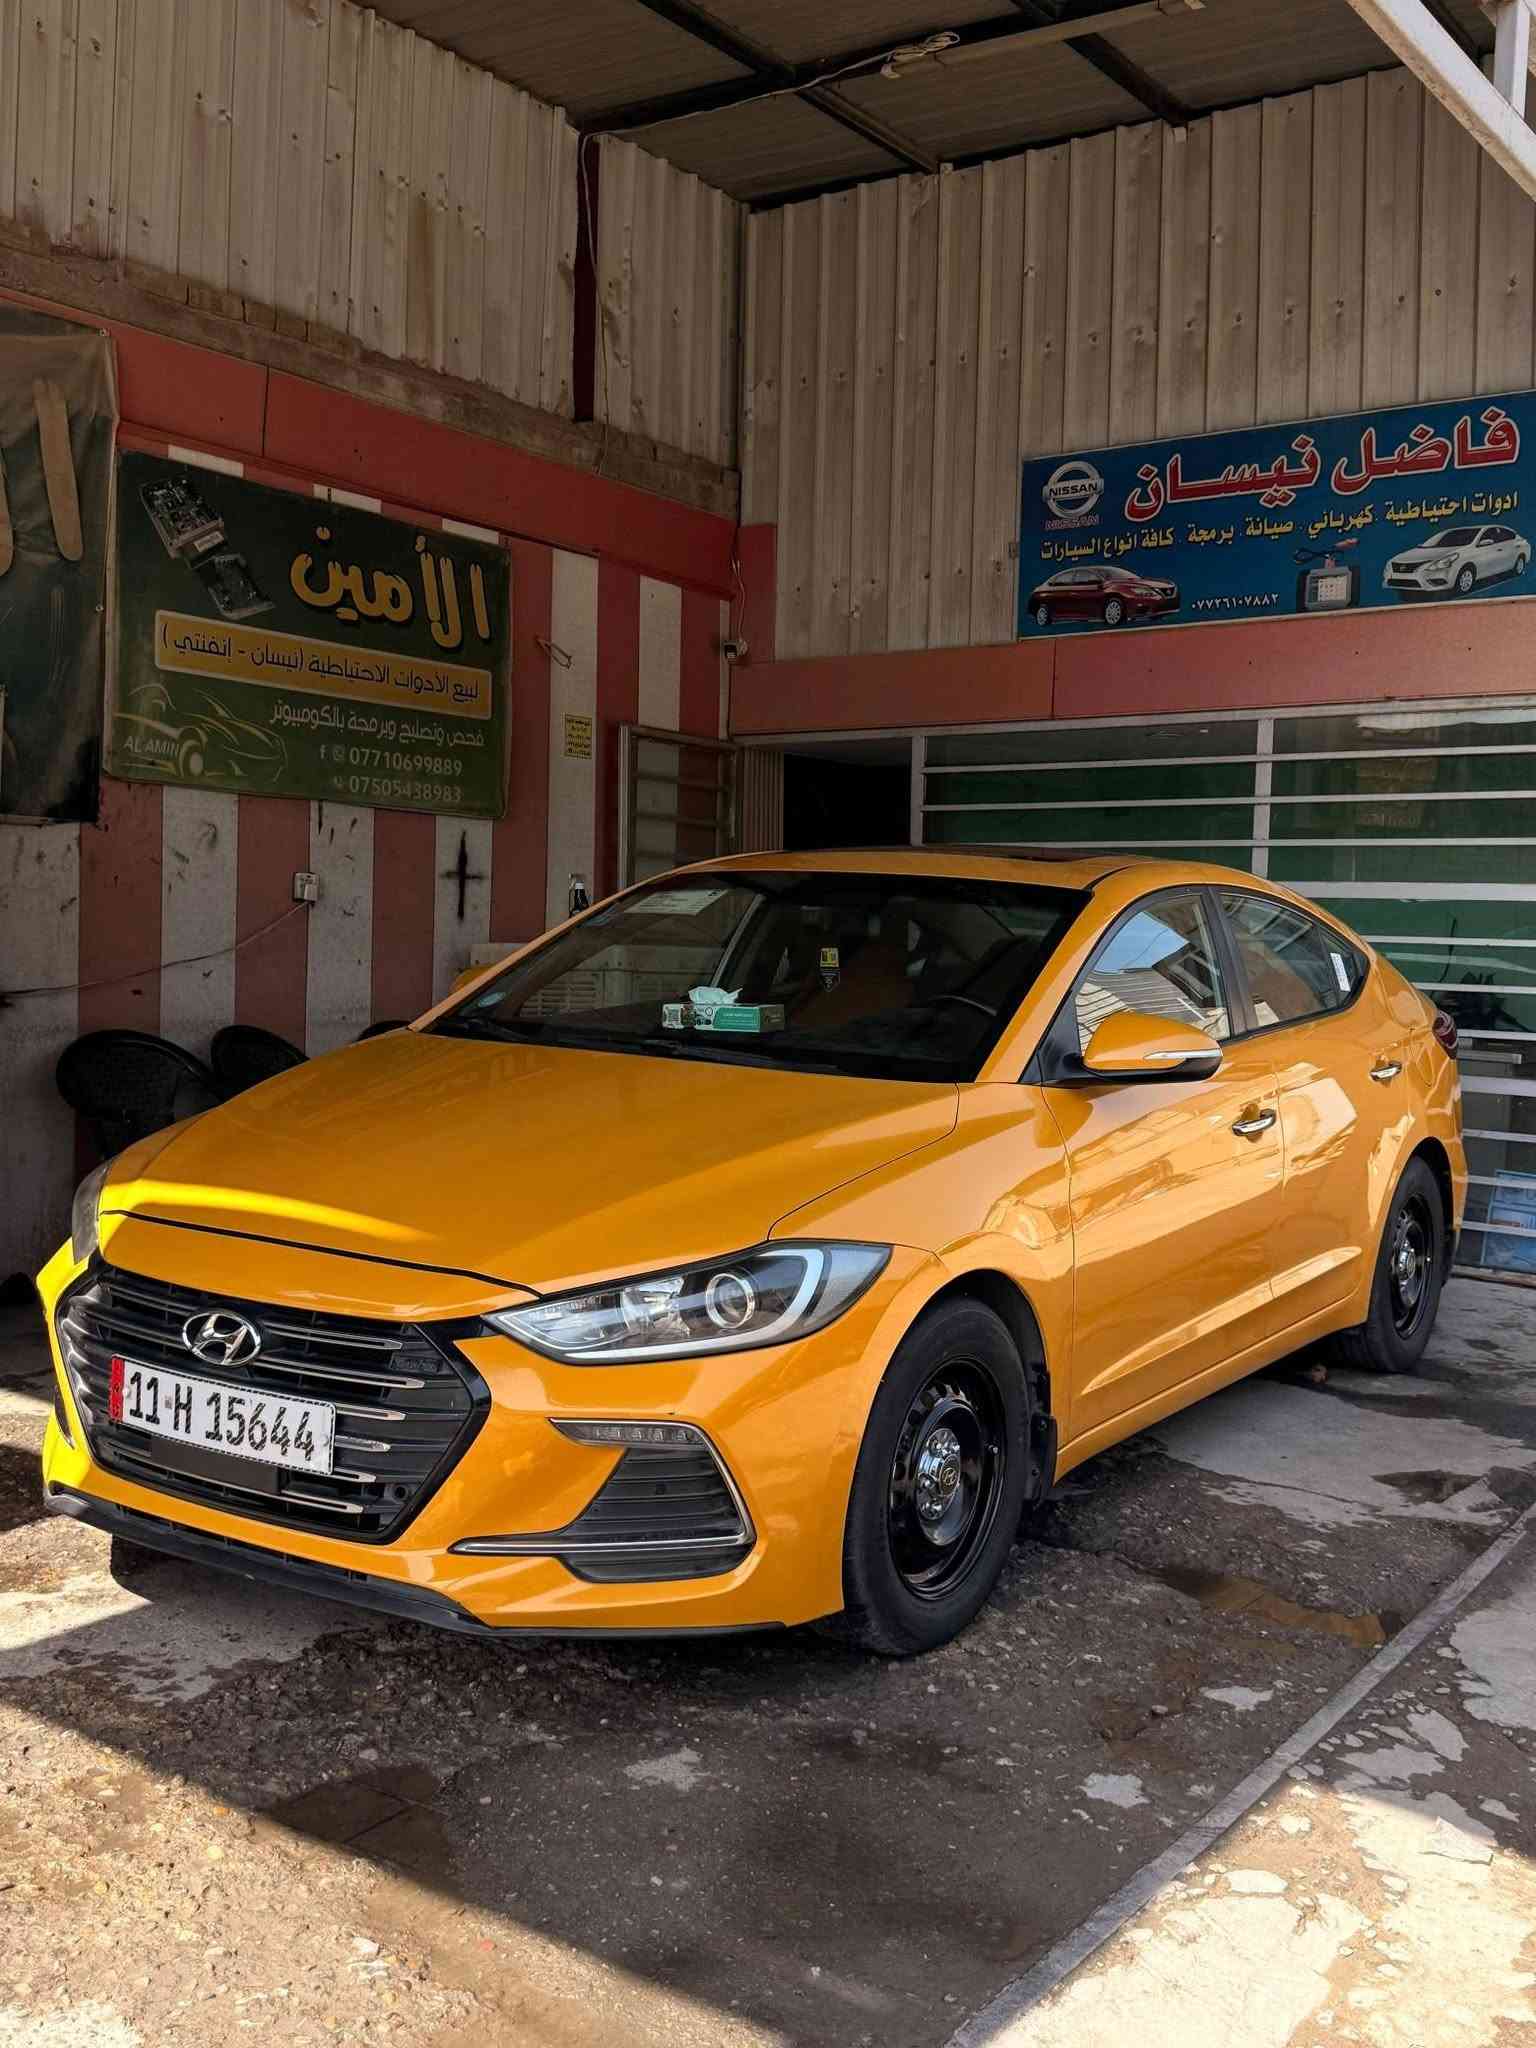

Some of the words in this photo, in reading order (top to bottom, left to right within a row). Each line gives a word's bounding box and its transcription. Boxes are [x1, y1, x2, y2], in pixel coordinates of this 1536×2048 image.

[1330, 405, 1520, 496] فاضل
[1049, 483, 1098, 497] NISSAN
[1124, 433, 1322, 522] نيسان
[1385, 495, 1468, 527] احتياطية
[1471, 490, 1518, 516] ادوات
[1140, 527, 1175, 548] كافة
[1187, 523, 1234, 546] برمجة
[1245, 516, 1294, 539] صيانة
[1040, 536, 1101, 561] السيارات
[1103, 532, 1138, 558] انواع
[289, 526, 492, 649] الأمين
[308, 655, 390, 684] الاحتياطية
[394, 667, 449, 694] الأدوات
[450, 679, 481, 704] لبيع
[447, 728, 485, 748] فحص
[349, 747, 463, 776] 07710699889
[129, 1371, 160, 1425] 11
[173, 1382, 193, 1434] H
[205, 1392, 315, 1462] 15644
